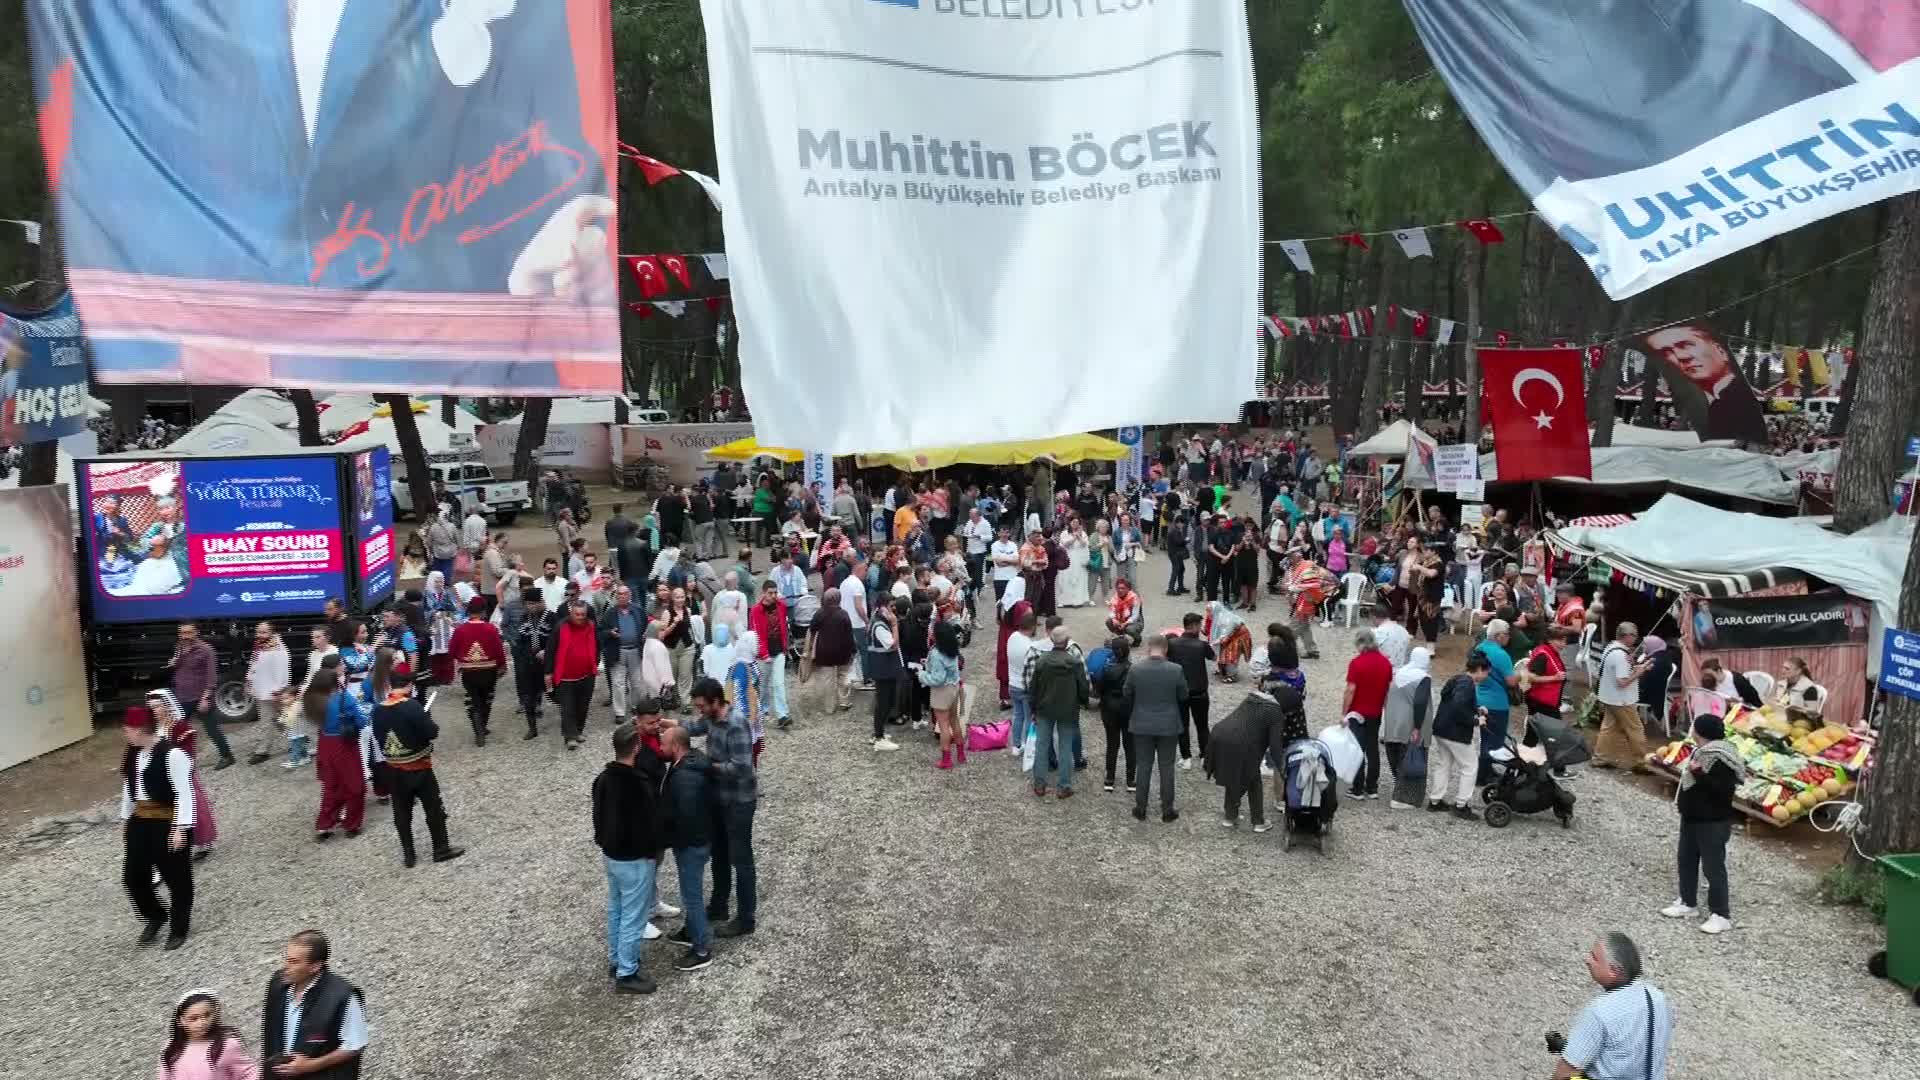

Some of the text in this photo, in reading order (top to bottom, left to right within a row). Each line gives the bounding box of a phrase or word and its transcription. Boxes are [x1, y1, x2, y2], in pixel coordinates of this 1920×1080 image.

[798, 120, 1218, 182] Muhittin BÖCEK
[1603, 101, 1920, 240] UHİTTİN
[804, 166, 1221, 208] Antalya Büyükşehir Belediye Başkanı
[1639, 148, 1920, 264] ALYA BÜYÜKŞEHİR
[14, 387, 56, 428] HOŞ
[202, 534, 330, 552] UMAY SOUND
[1715, 616, 1744, 626] GARA
[1788, 613, 1809, 624] ÇUL
[1810, 610, 1846, 623] ÇADIRI
